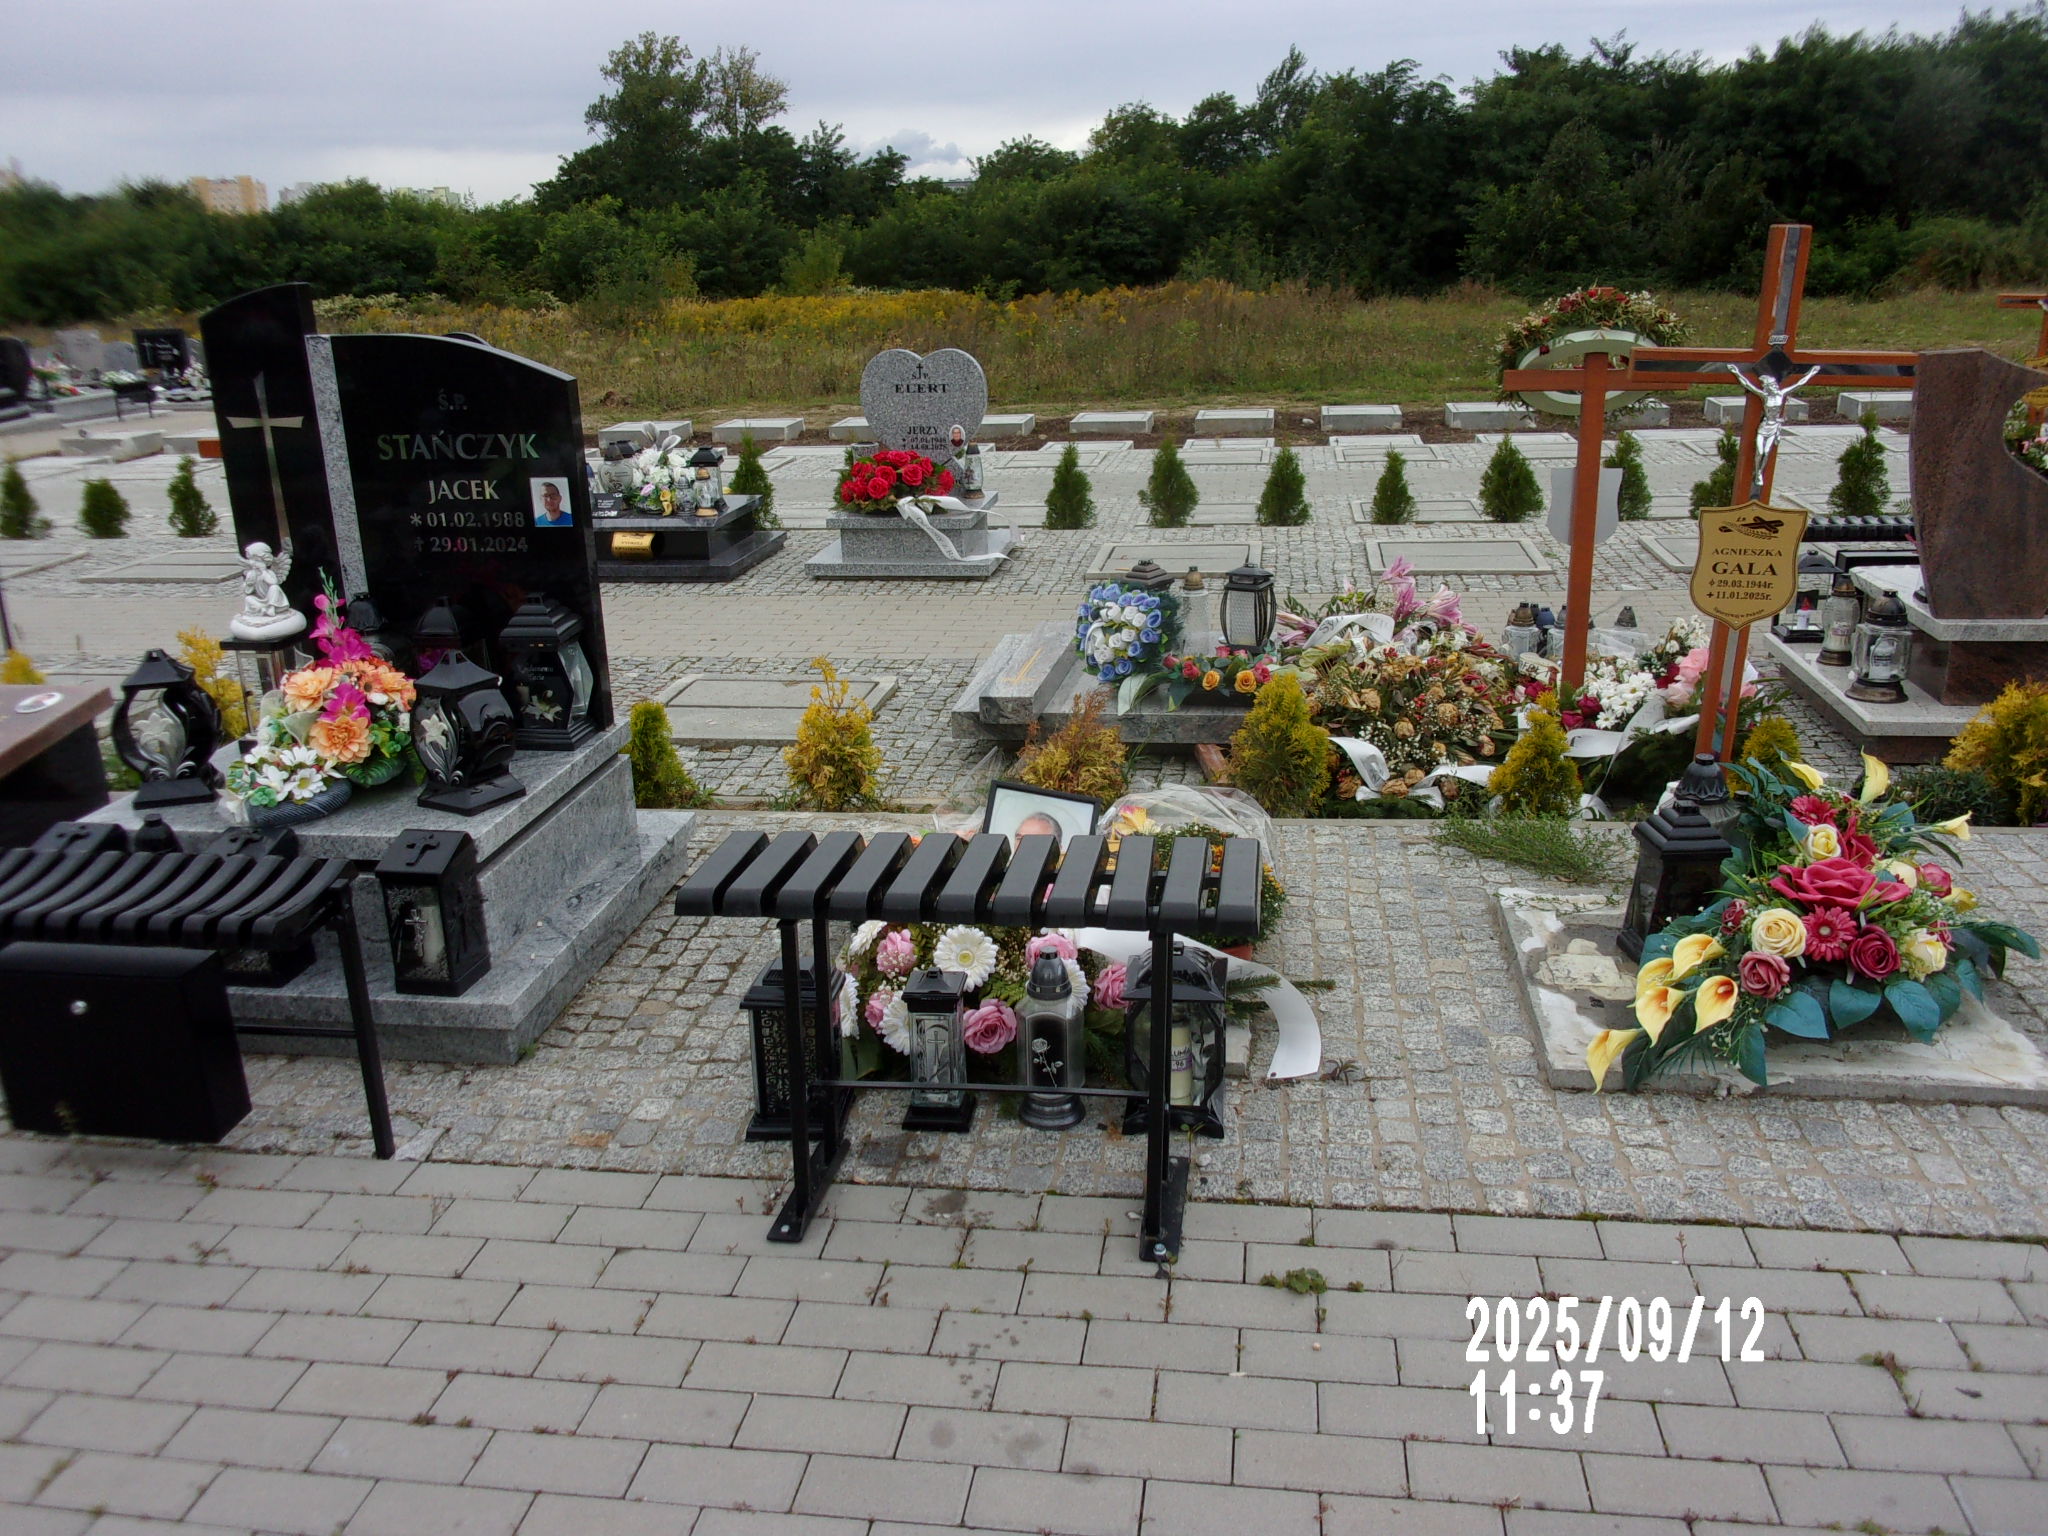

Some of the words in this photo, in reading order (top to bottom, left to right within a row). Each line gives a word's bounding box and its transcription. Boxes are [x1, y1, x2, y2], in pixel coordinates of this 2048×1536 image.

[895, 384, 948, 393] ELERT
[906, 425, 939, 436] JERZY
[376, 429, 541, 461] STAŃCZYK
[428, 479, 500, 504] JACEK
[426, 511, 525, 528] 01.02.1988
[429, 536, 529, 553] 29.01.2024
[1711, 548, 1782, 557] AGNIESZKA
[1711, 562, 1777, 576] GALA
